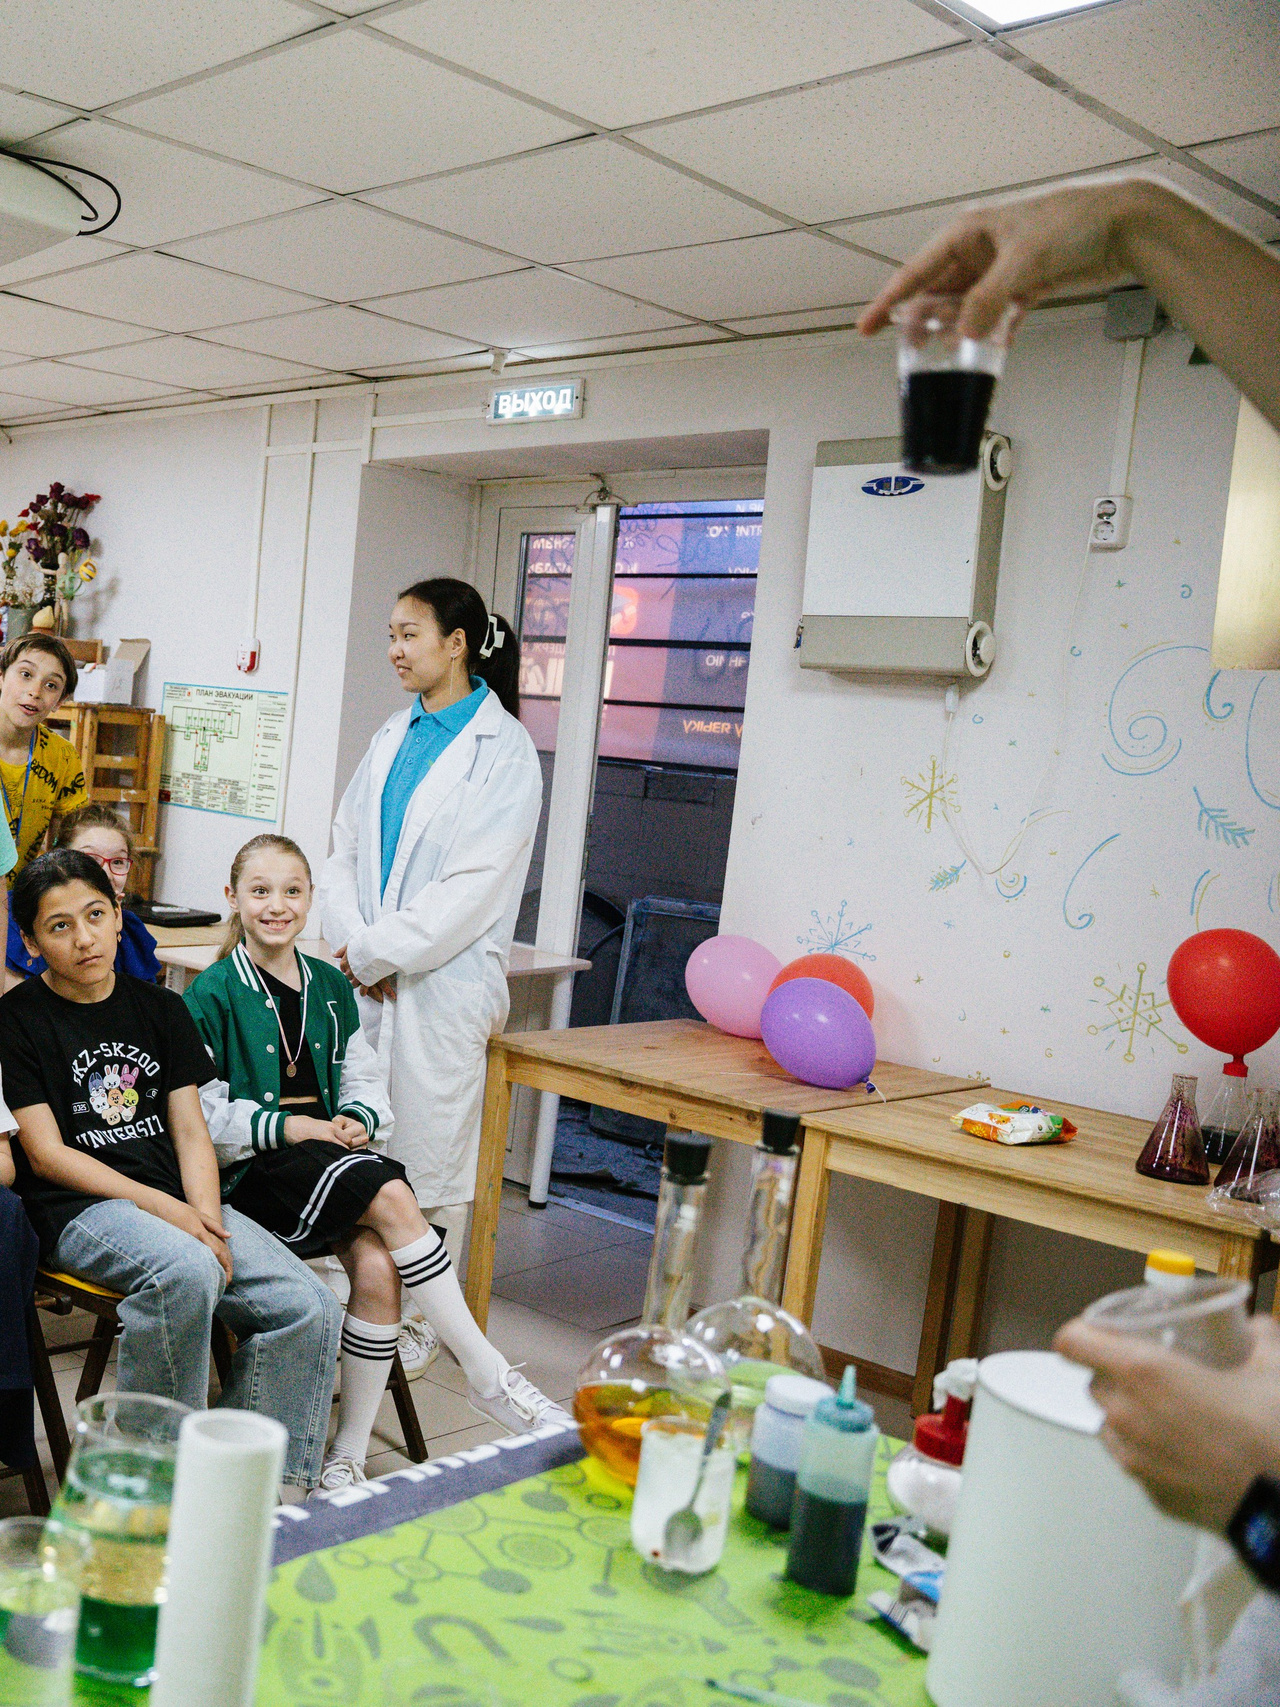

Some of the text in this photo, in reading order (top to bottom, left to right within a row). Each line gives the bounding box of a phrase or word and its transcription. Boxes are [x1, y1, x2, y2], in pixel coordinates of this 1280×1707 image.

[498, 388, 571, 414] ВЫХОД
[195, 688, 214, 697] ПЛАН
[214, 690, 254, 701] ЭВАКУАЦИИ
